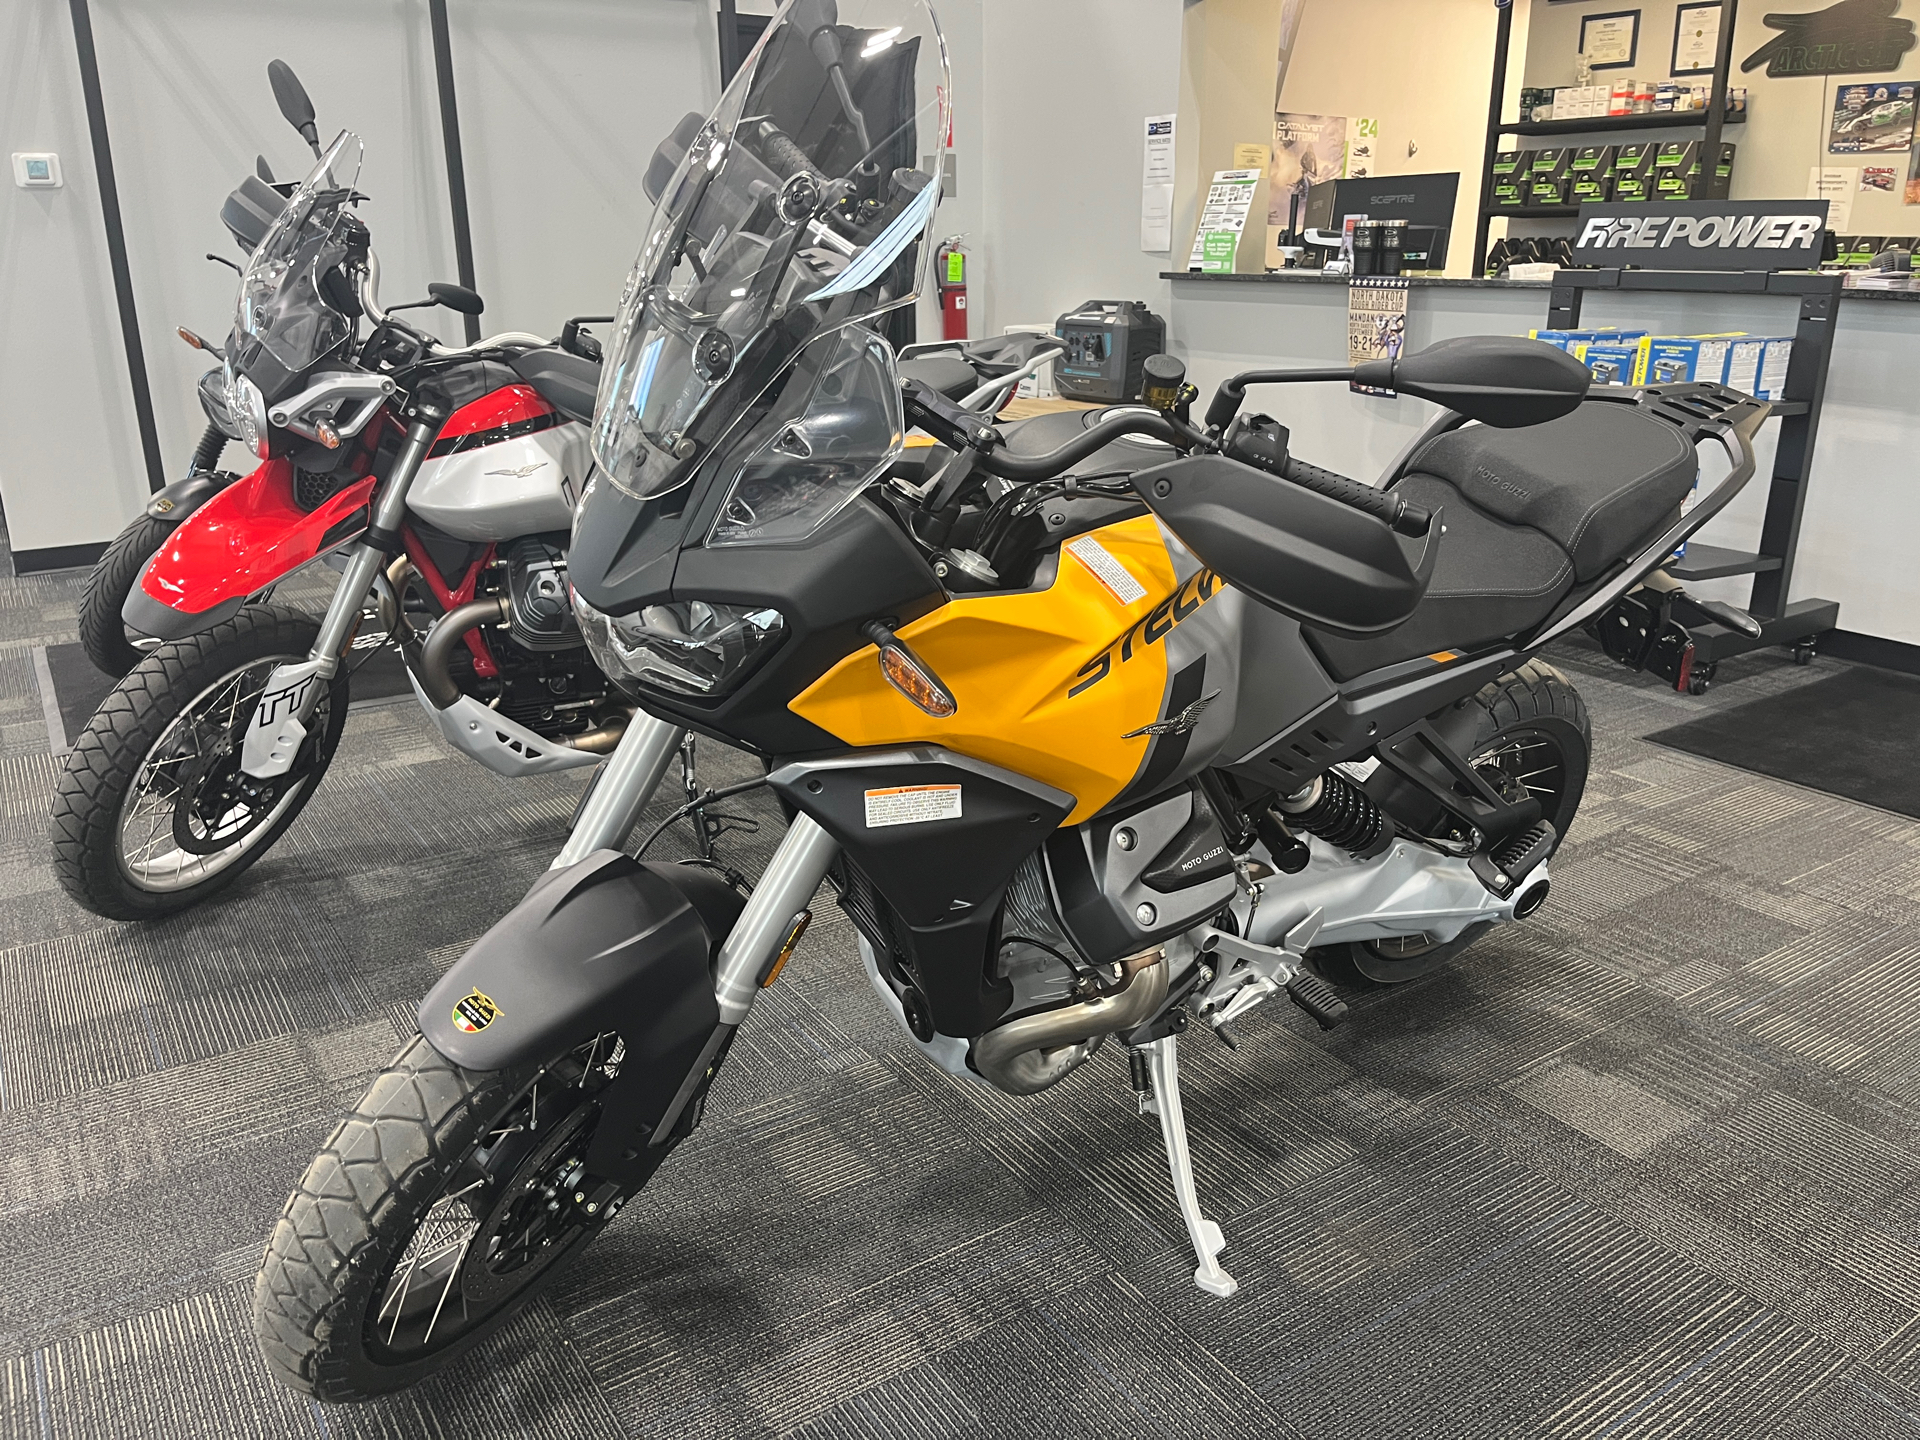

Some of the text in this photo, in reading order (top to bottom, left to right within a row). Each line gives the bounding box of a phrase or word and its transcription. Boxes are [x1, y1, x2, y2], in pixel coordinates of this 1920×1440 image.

[1771, 43, 1856, 73] ARCTIC
[1278, 122, 1324, 132] CATALYST
[1276, 130, 1320, 142] PLATFORM
[1370, 194, 1415, 204] SCEPTRE
[1576, 216, 1822, 249] FIRE POWER
[1352, 290, 1403, 302] NORTH DAKOTA
[1372, 301, 1388, 310] RIDER
[1391, 302, 1403, 310] CUP
[1350, 313, 1375, 322] MANDAN
[1350, 335, 1372, 351] 19-21
[1476, 466, 1531, 500] MOTO GUZZI
[259, 671, 318, 728] TT
[1182, 846, 1224, 871] MOTO GUZZI
